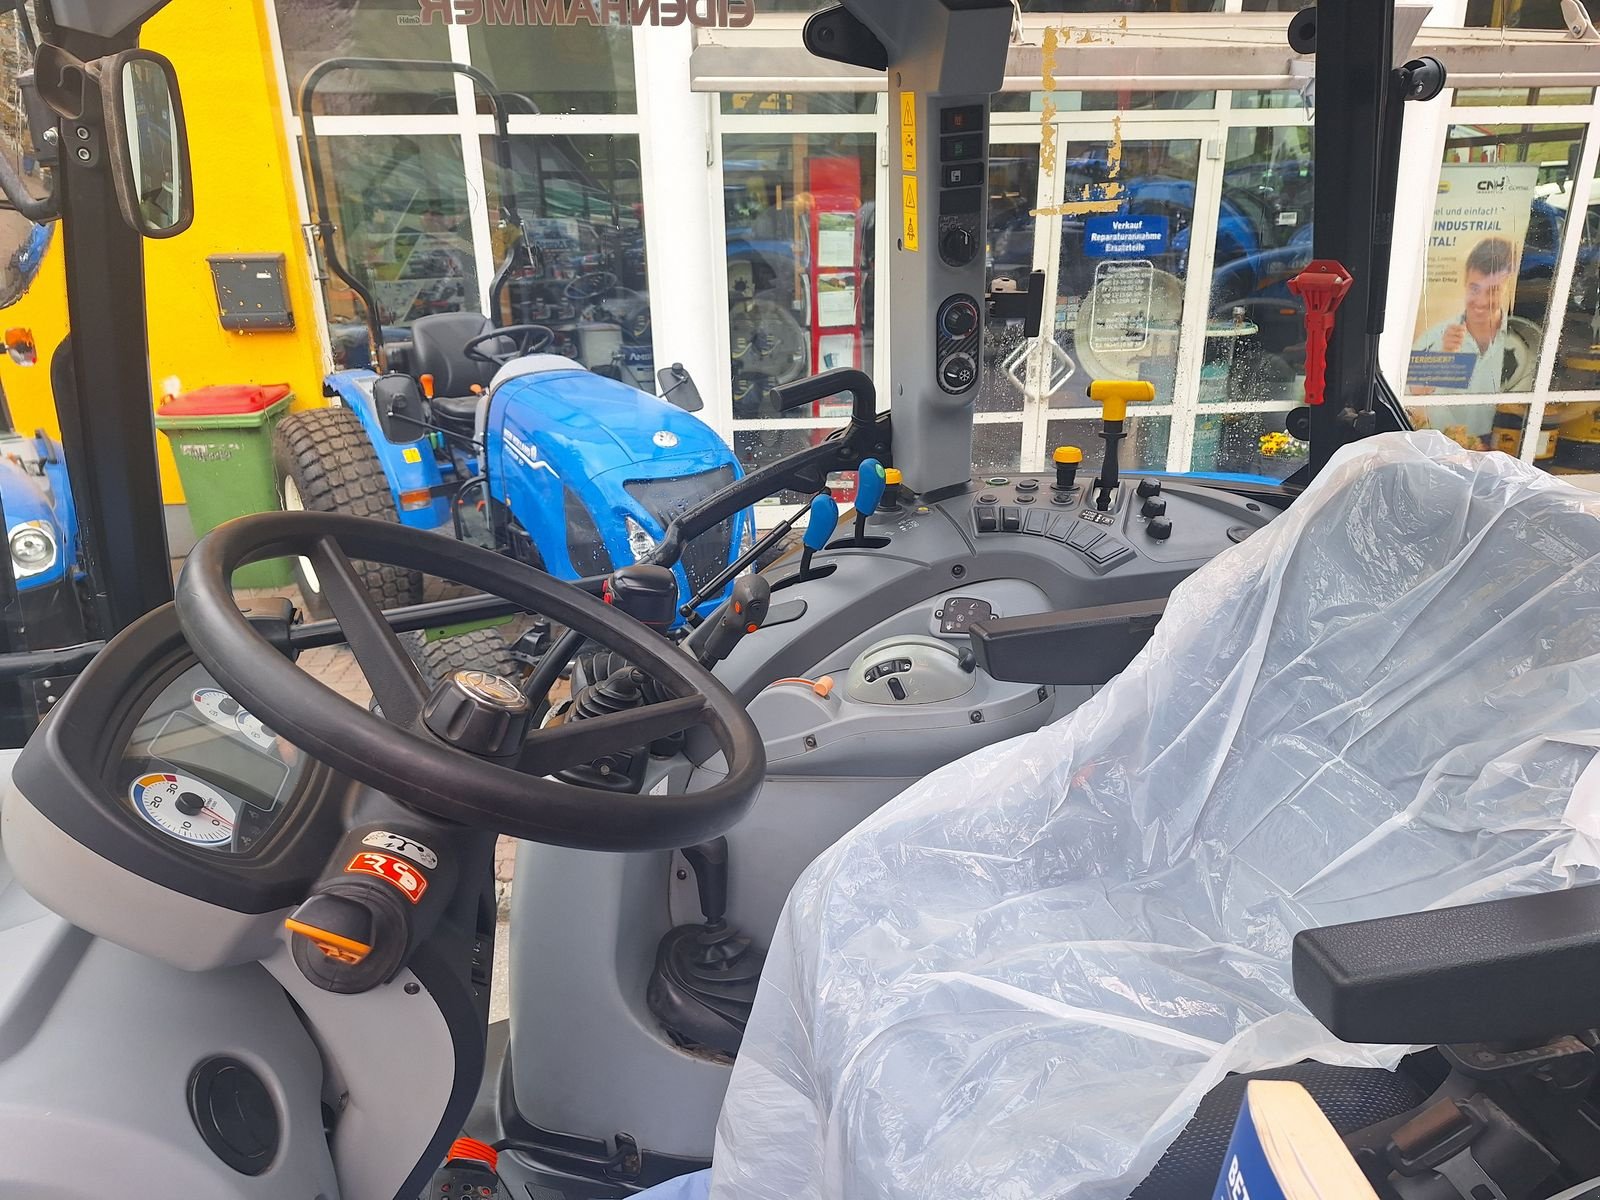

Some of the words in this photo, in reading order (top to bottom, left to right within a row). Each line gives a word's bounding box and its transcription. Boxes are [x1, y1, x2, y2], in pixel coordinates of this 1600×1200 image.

[1445, 207, 1461, 215] und
[1112, 220, 1143, 230] Verkauf
[1434, 220, 1502, 231] INDUSTRIAL
[1090, 232, 1162, 243] Reparaturannahme
[1105, 243, 1146, 252] Ersatzteile
[166, 783, 179, 795] 30
[150, 796, 163, 809] 20
[181, 820, 192, 831] 10
[211, 819, 221, 827] 0
